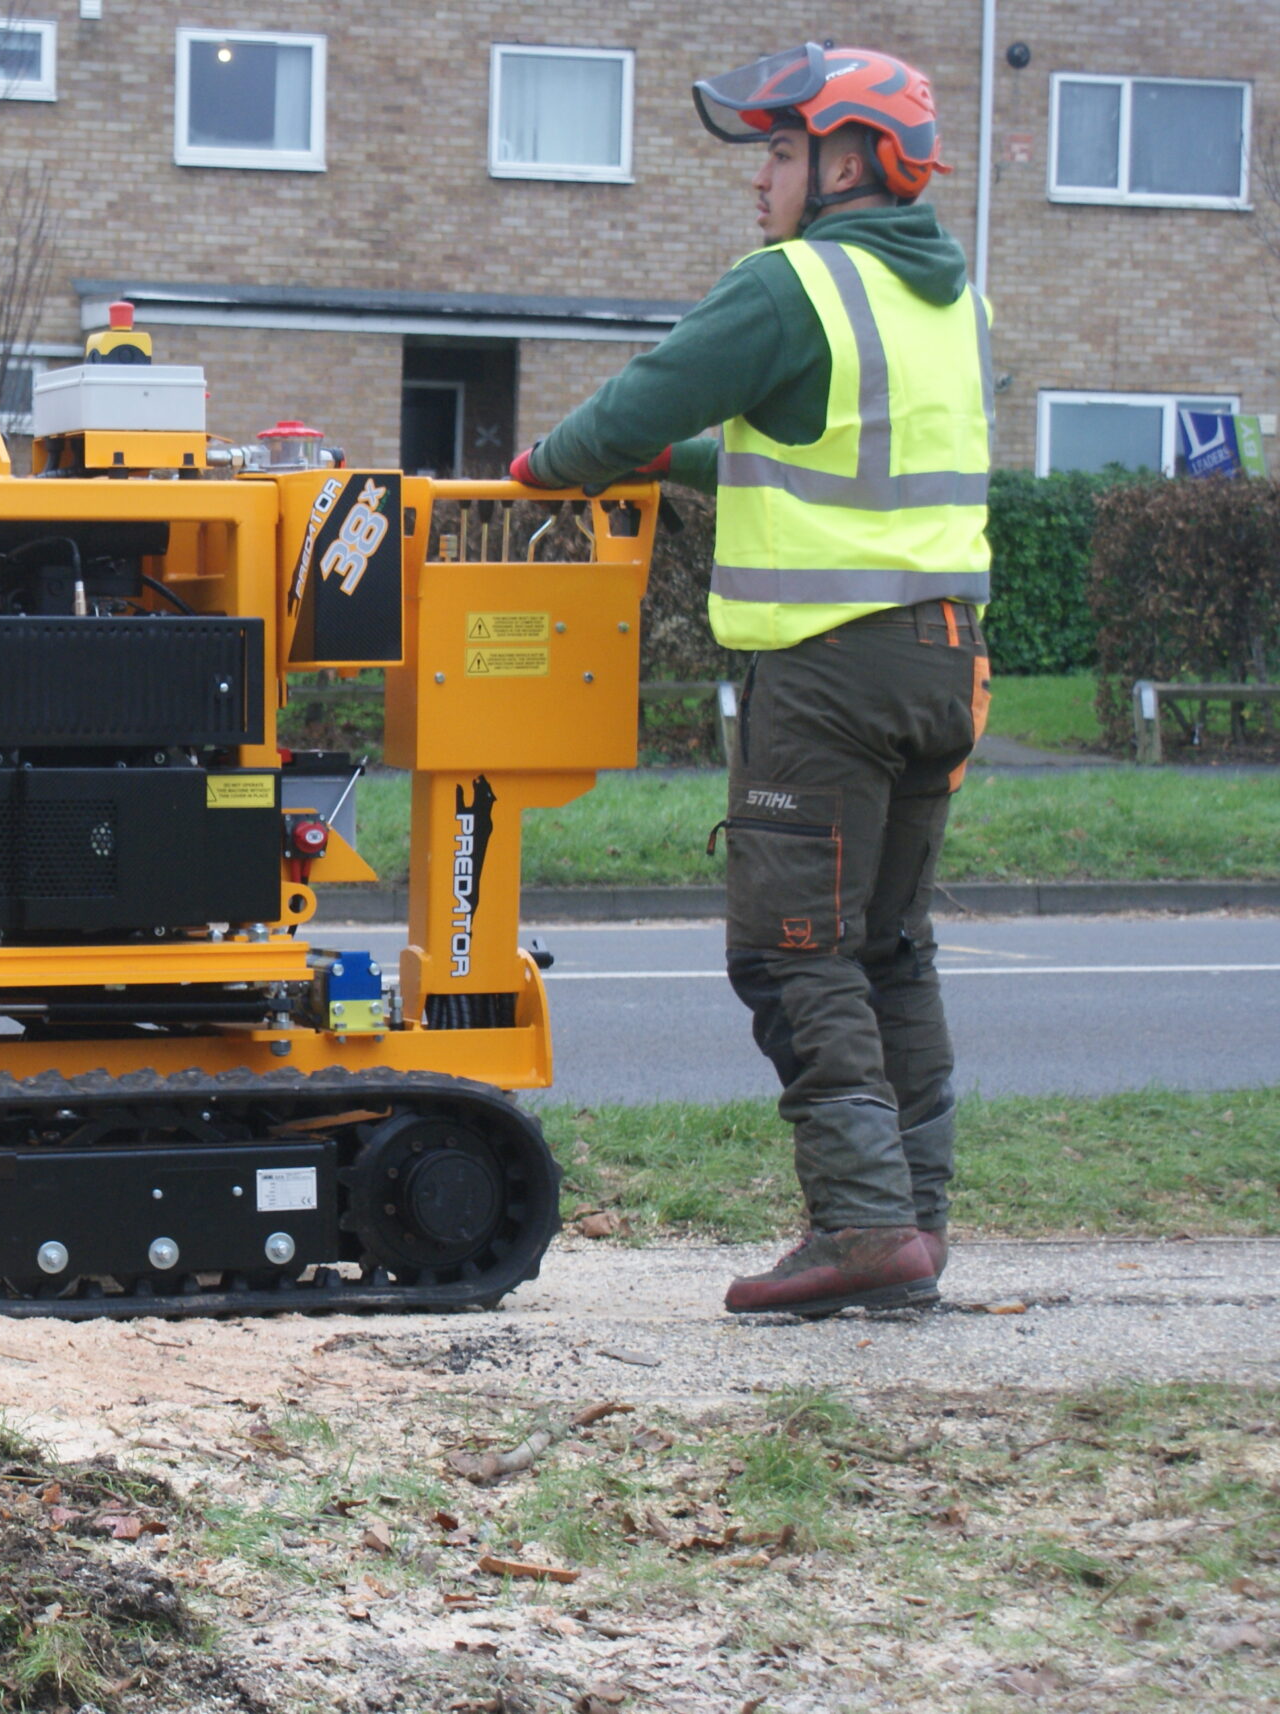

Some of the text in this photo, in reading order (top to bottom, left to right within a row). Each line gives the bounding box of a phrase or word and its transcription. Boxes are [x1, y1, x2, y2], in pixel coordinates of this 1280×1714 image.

[295, 478, 343, 600] PREDATOR
[746, 790, 797, 809] STIHL
[450, 813, 475, 978] PREDATOR
